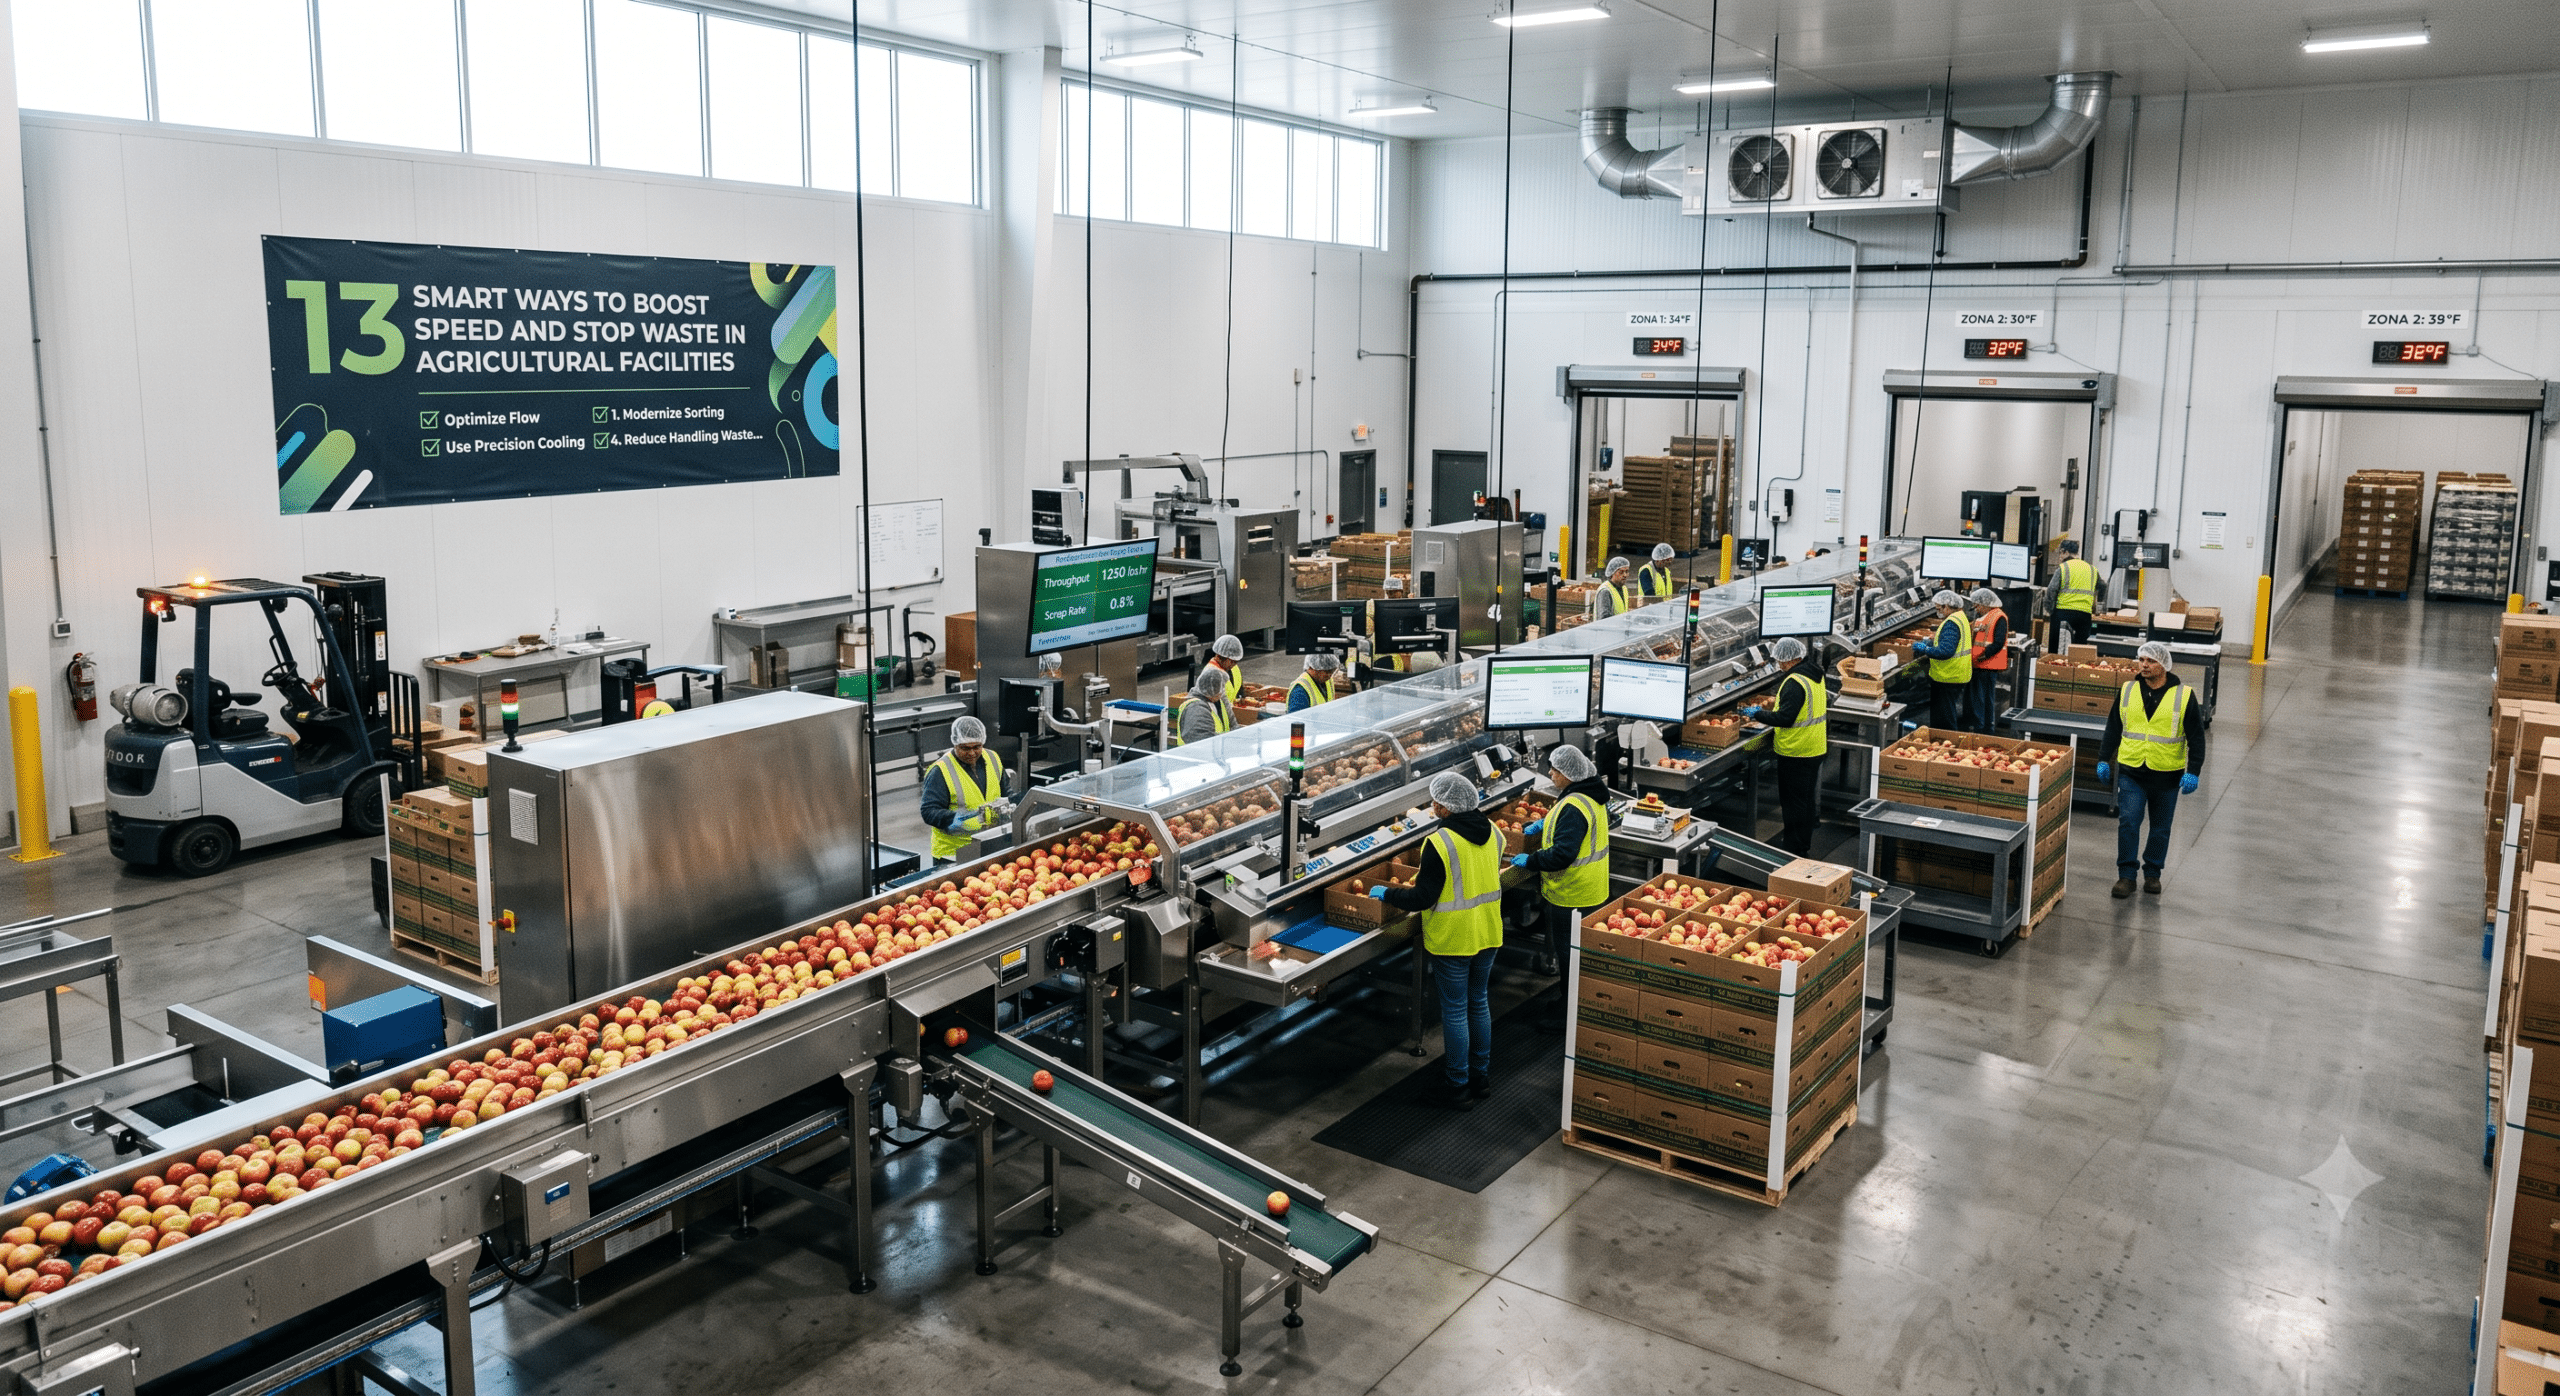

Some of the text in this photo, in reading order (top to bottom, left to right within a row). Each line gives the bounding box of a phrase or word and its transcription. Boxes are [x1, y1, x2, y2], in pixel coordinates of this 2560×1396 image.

[413, 284, 710, 315] SMART WAYS TO BOOST
[1631, 315, 1691, 323] ZONA 1: 34°F
[1961, 314, 2037, 324] ZONA 2: 30°F
[2368, 314, 2408, 324] ZONA
[2413, 314, 2424, 324] 2:
[285, 279, 406, 375] 13
[414, 317, 746, 344] SPEED AND STOP WASTE IN
[1988, 341, 2024, 356] 32°F
[415, 350, 735, 373] AGRICULTURAL FACILITIES
[444, 411, 541, 429] Optimize Flow
[611, 405, 725, 421] 1. Modernize Sorting
[446, 435, 586, 454] Use Precision Cooling
[610, 429, 764, 446] 4. Reduce Handling Waste...
[1102, 566, 1126, 580] 1250
[1045, 574, 1090, 588] Throughput
[1110, 595, 1134, 610] 0.8%
[1069, 606, 1086, 616] Rate
